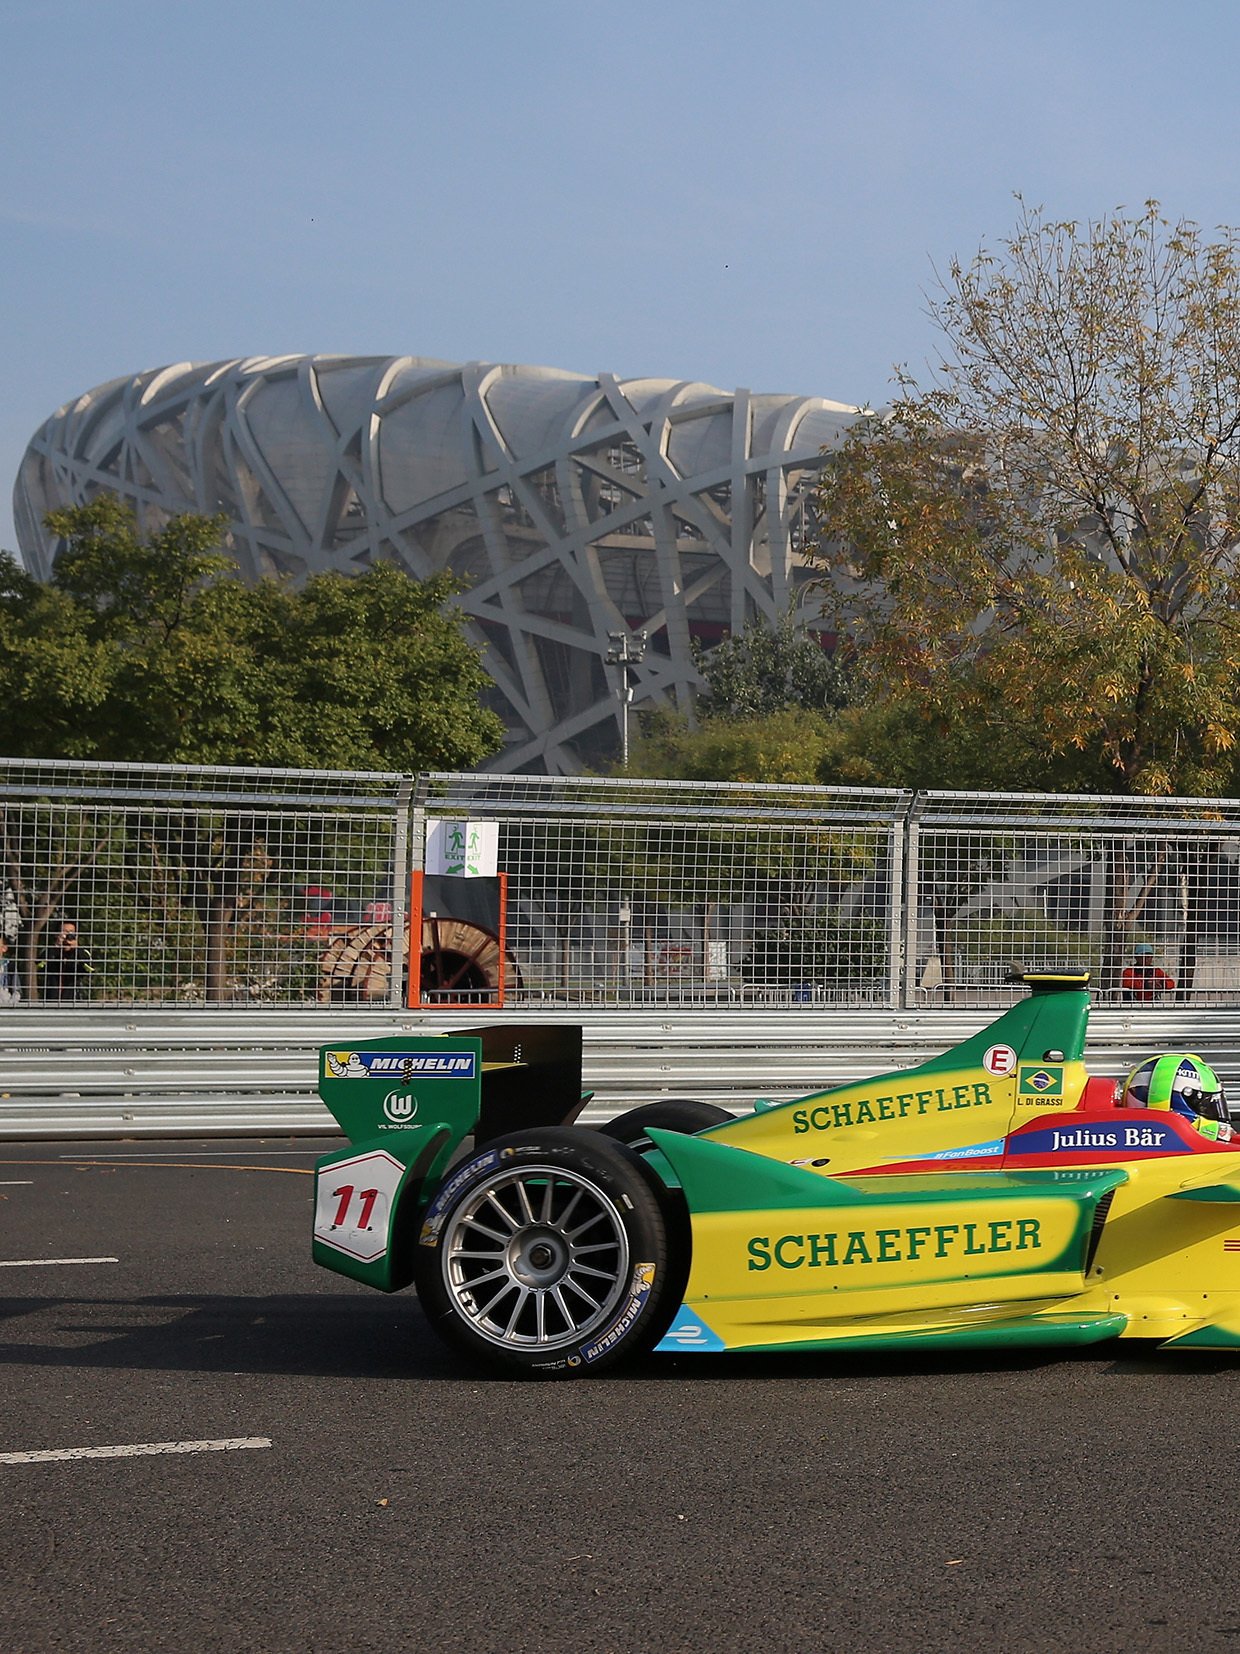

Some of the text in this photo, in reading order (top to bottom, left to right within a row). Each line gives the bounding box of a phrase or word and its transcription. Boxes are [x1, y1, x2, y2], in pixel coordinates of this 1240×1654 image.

[369, 1058, 472, 1070] MICHELIN
[991, 1050, 1009, 1071] E
[793, 1083, 992, 1134] SCHAEFFLER
[1026, 1098, 1034, 1106] DI
[1035, 1098, 1063, 1106] GRASSI
[934, 1146, 999, 1159] #FanBoost
[1051, 1128, 1166, 1151] Julius Bär
[436, 1154, 495, 1211] MICHELIN
[336, 1185, 378, 1229] 11
[746, 1218, 1042, 1271] SCHAEFFLER
[587, 1298, 642, 1358] MICHELIN
